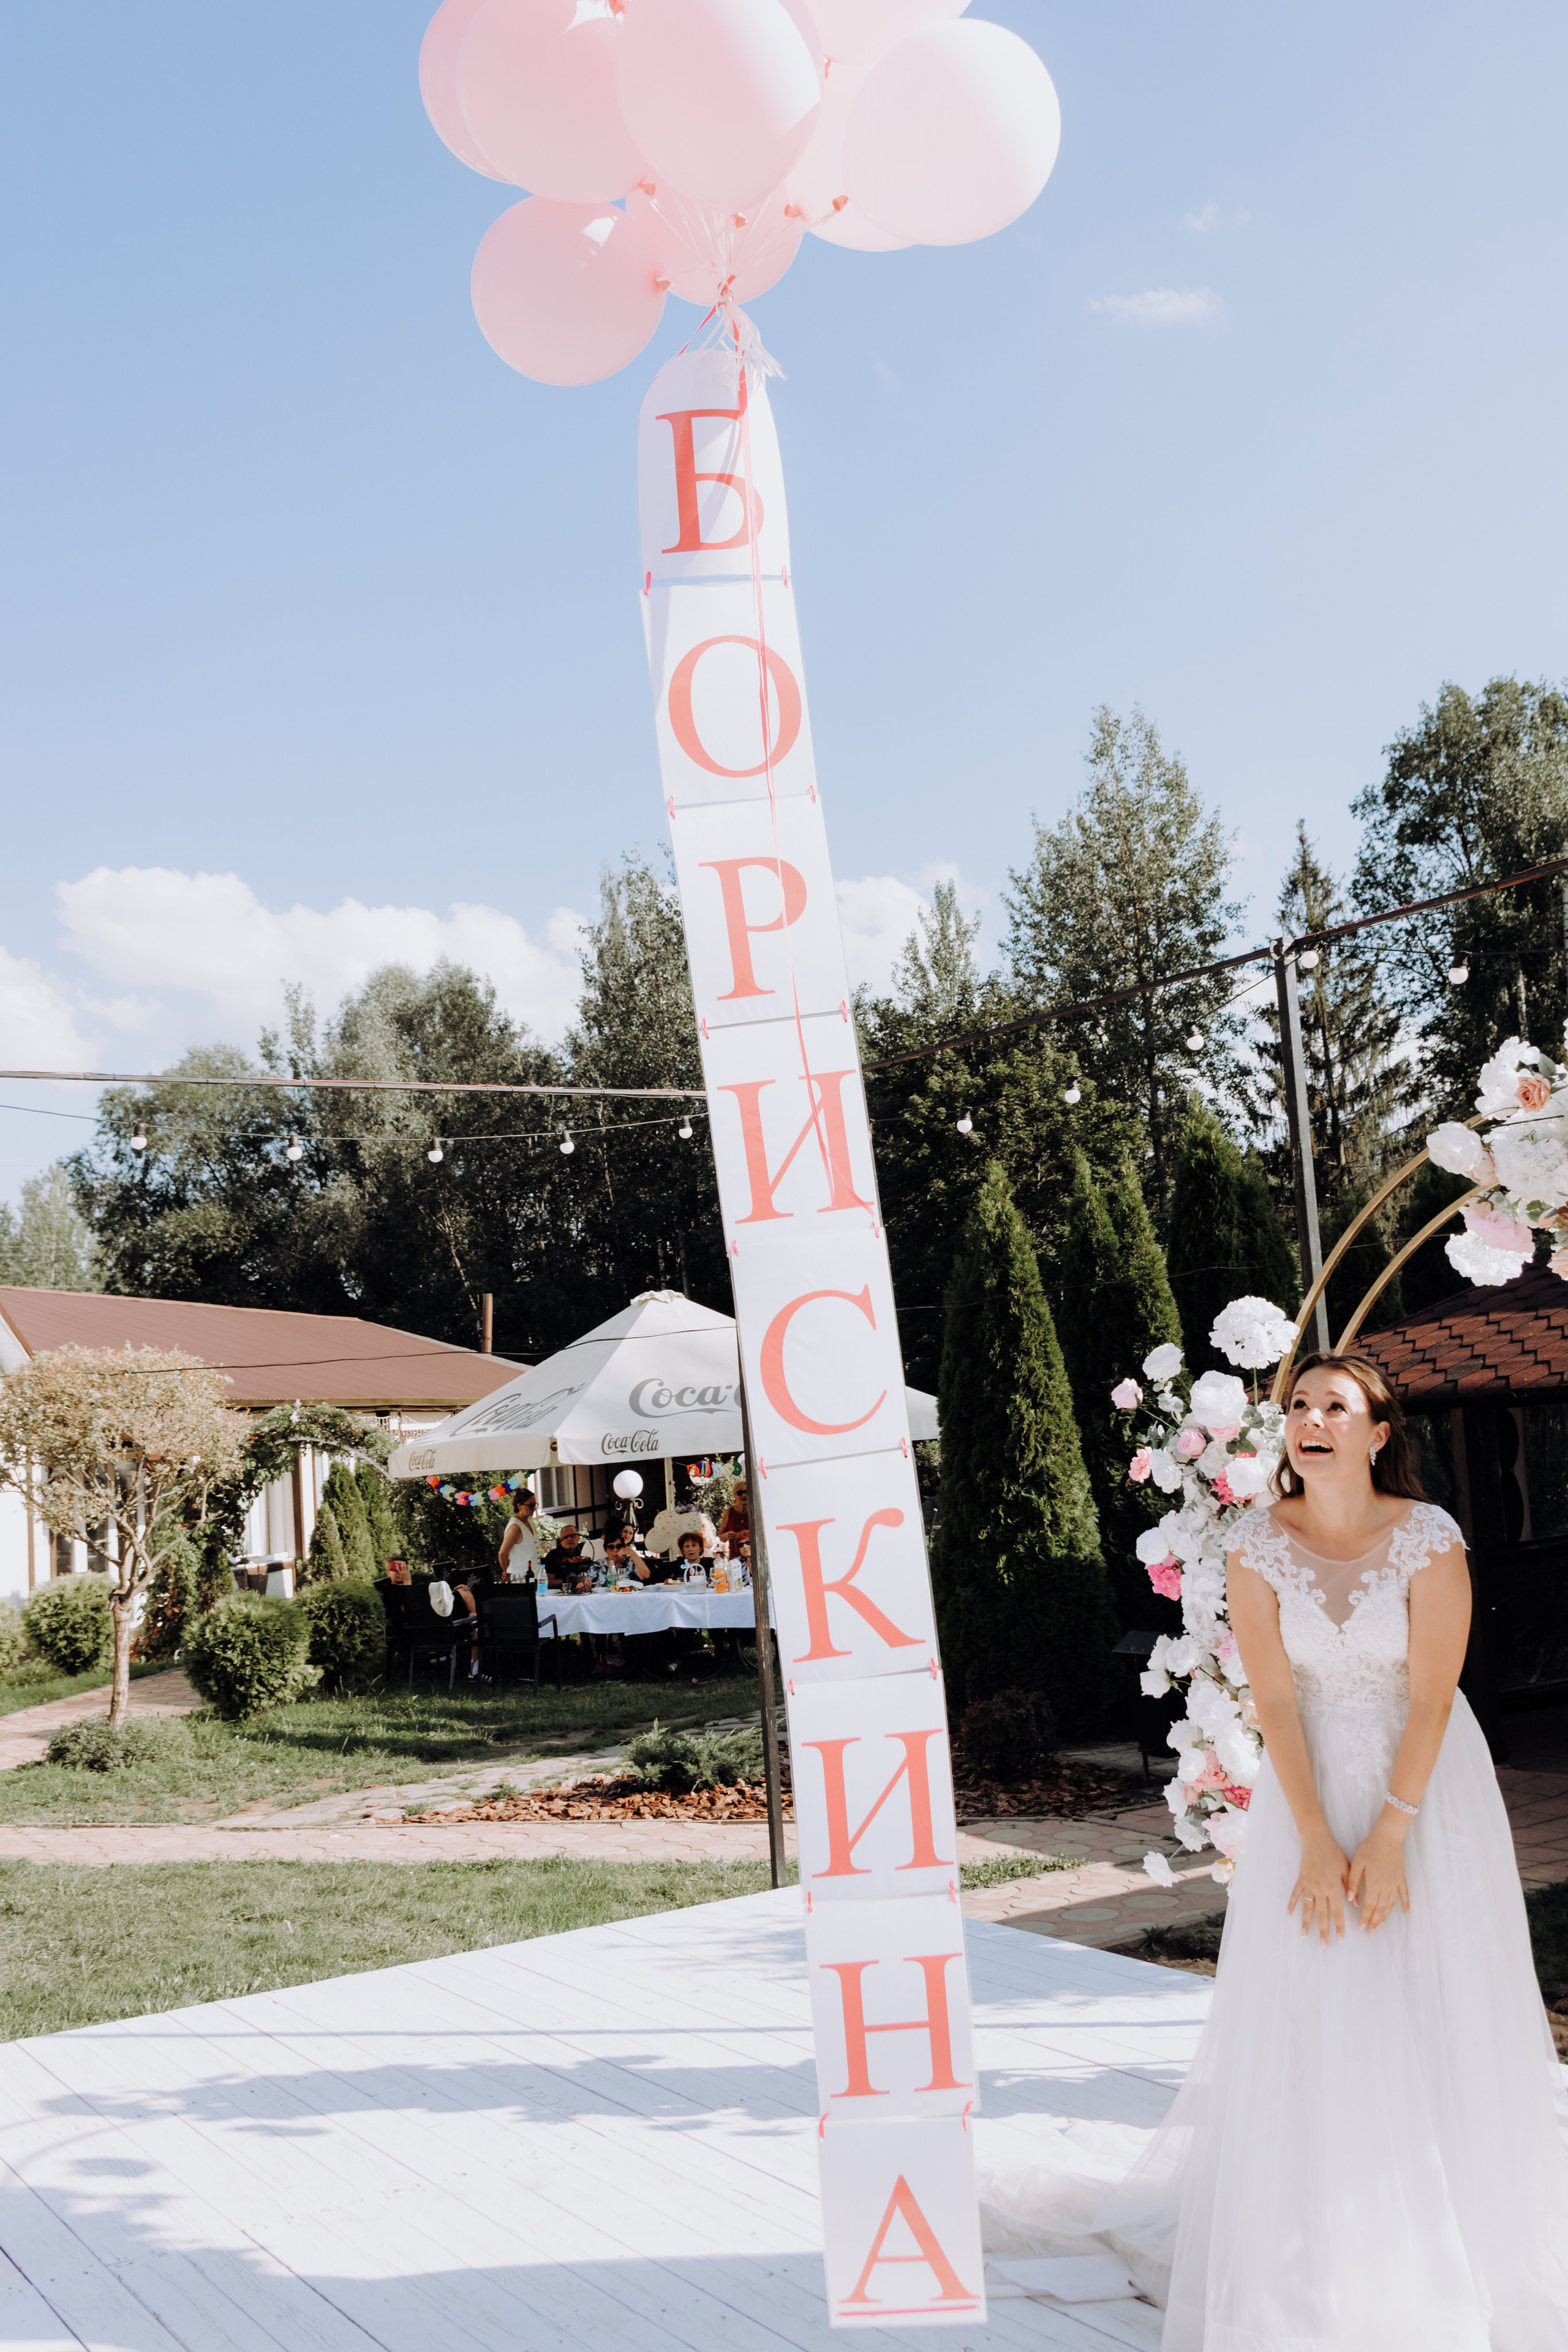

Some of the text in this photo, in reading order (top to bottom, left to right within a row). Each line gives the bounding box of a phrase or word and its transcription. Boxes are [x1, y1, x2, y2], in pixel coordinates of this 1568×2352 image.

[629, 1378, 742, 1419] Coca-
[601, 1428, 659, 1455] Coca-Cola
[409, 1448, 437, 1471] Coca-Cola
